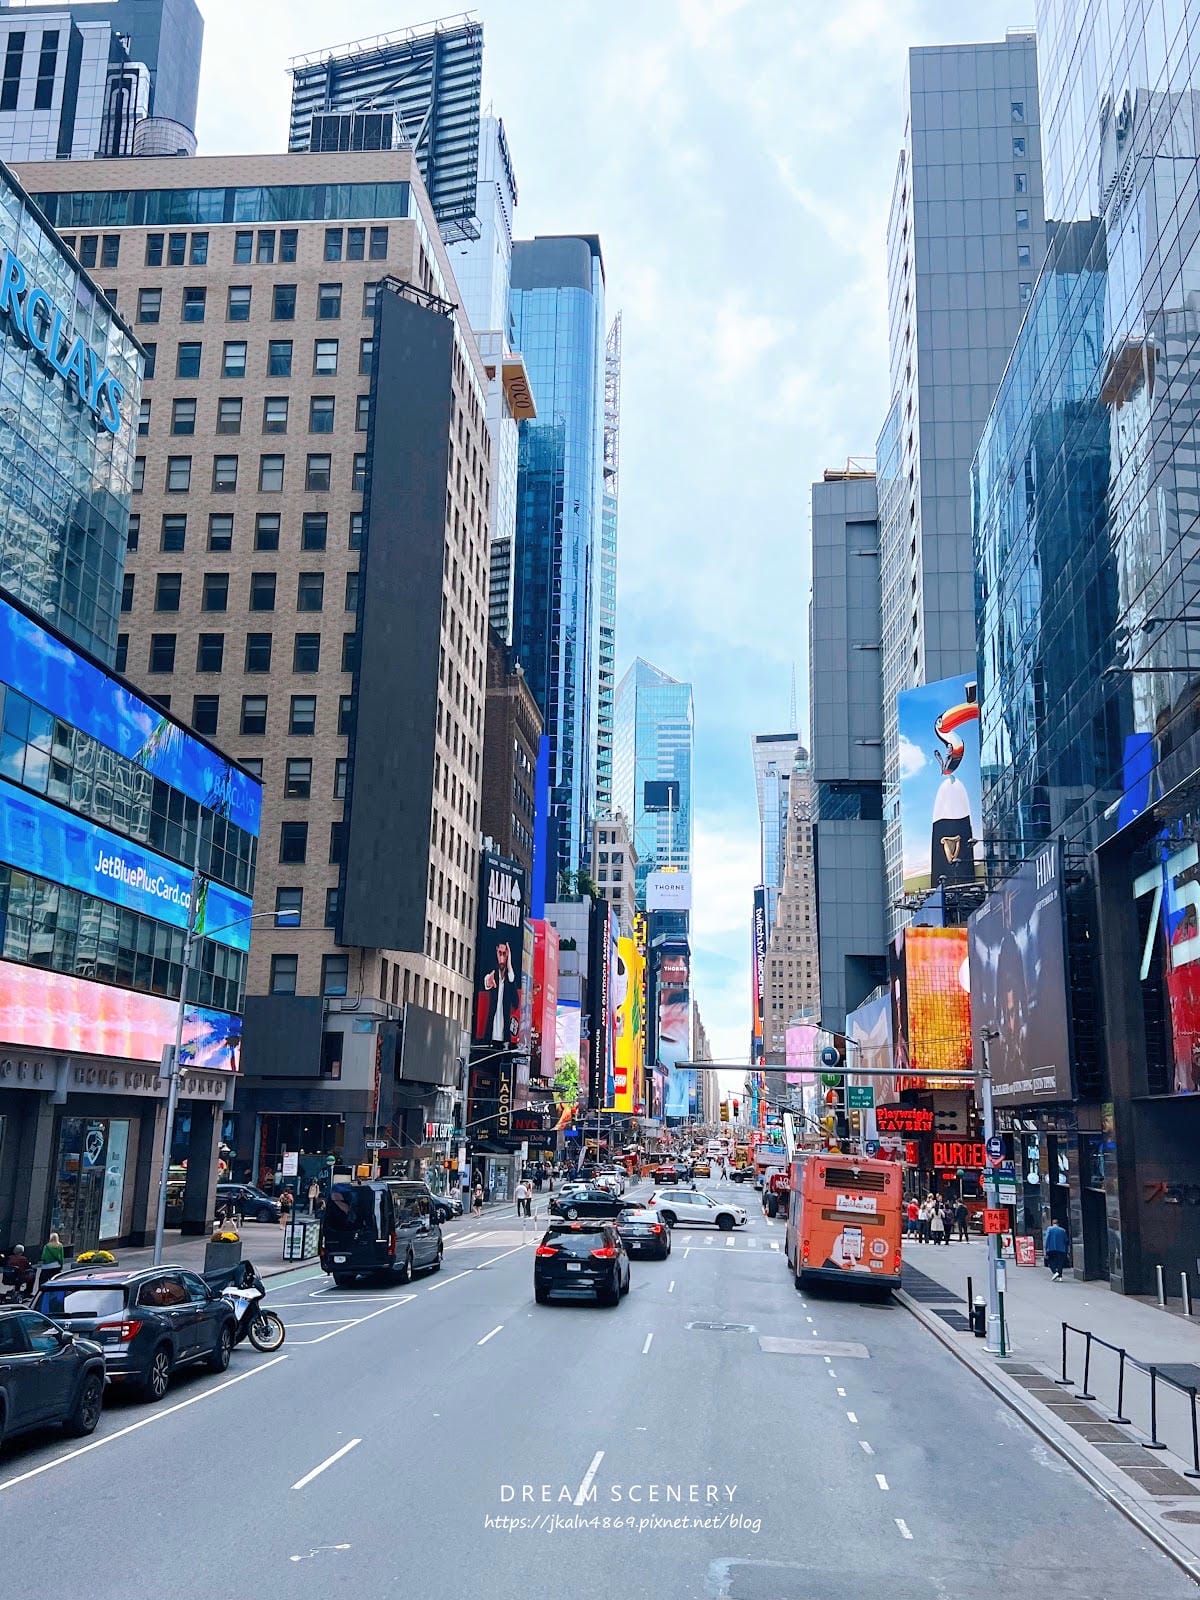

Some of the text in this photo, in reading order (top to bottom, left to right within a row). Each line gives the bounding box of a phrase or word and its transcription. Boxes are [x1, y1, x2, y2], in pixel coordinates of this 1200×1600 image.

[214, 775, 255, 817] BARCLAYS
[1035, 846, 1055, 890] HIM
[488, 868, 512, 904] ALAN
[487, 897, 521, 929] MALAKOV
[74, 1067, 118, 1088] HONG
[124, 1072, 162, 1092] KONG
[498, 1072, 510, 1126] LAGOS
[877, 1108, 934, 1121] Playwright
[515, 1120, 538, 1129] NYC
[878, 1121, 932, 1131] TAVERN
